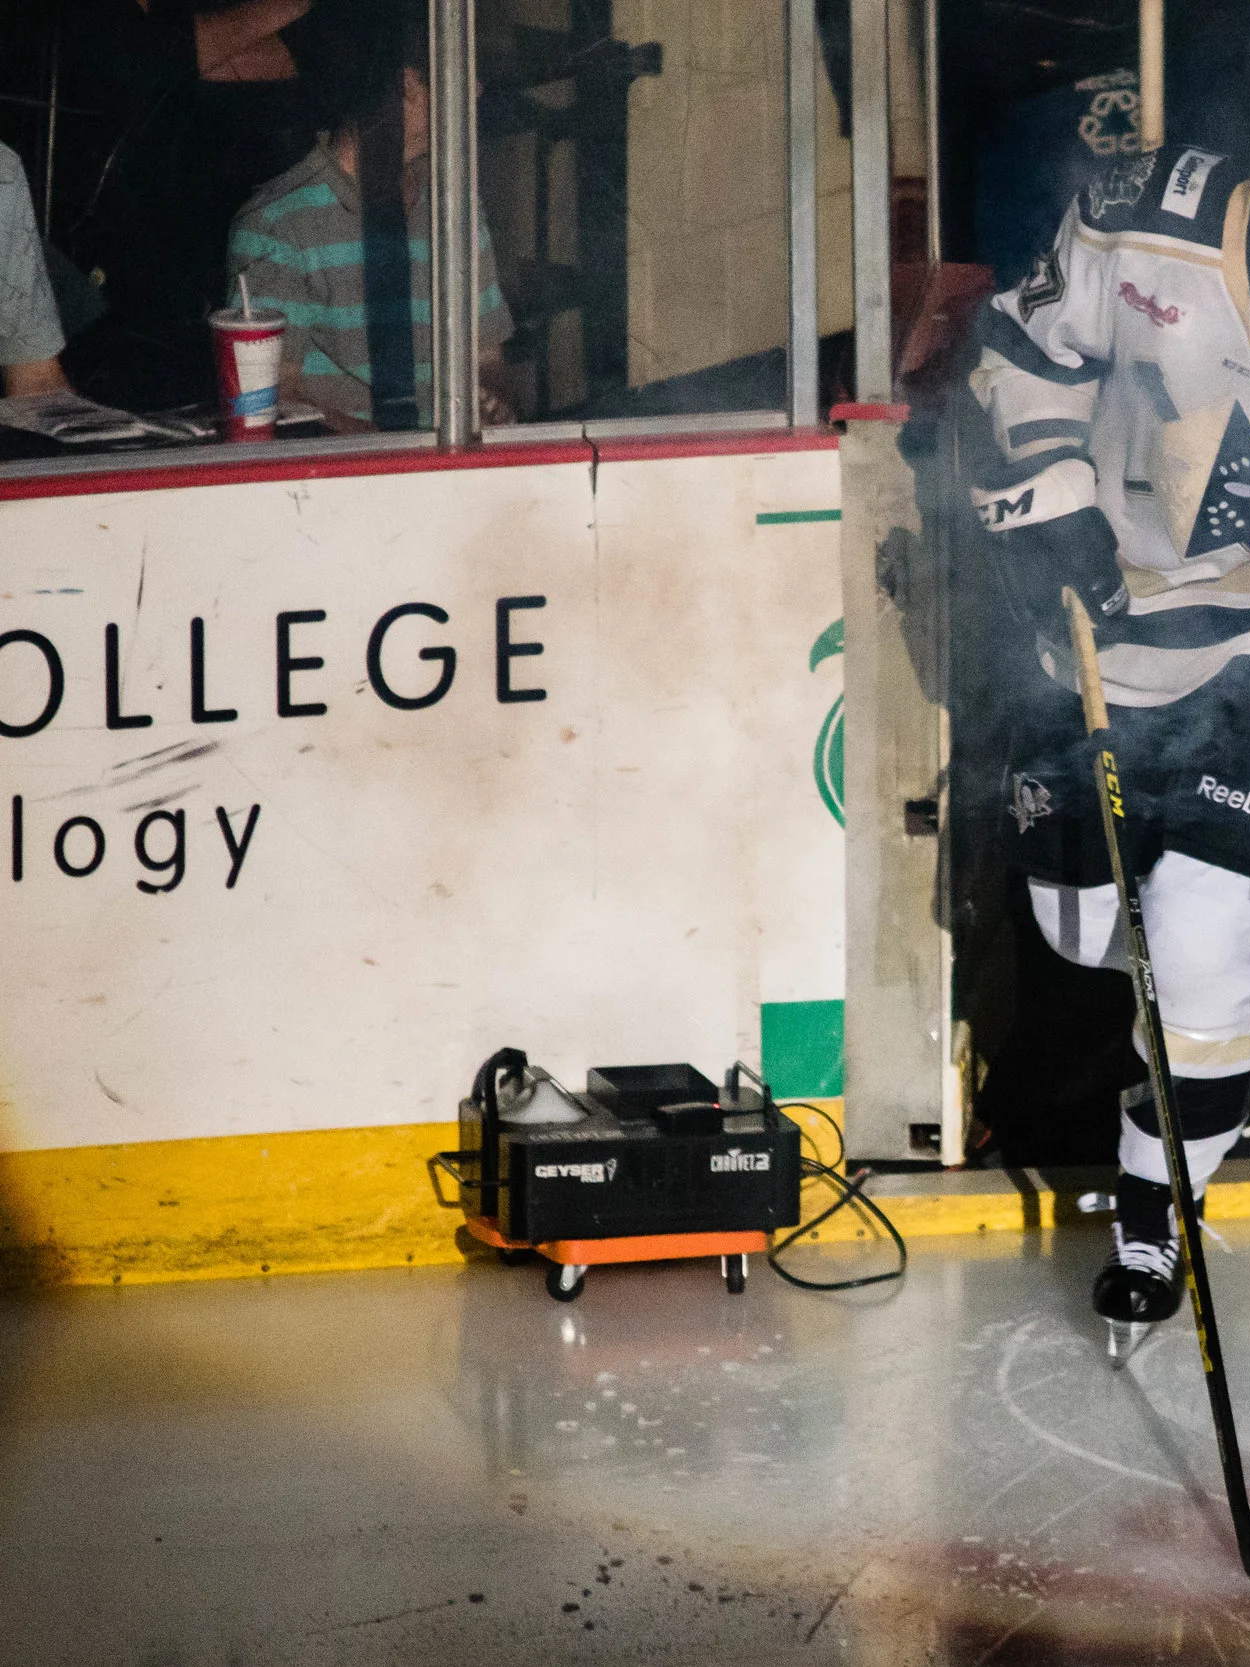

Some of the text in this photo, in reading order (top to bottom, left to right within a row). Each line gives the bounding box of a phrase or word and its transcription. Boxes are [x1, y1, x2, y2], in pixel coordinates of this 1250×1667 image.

[0, 595, 547, 738] OLLEGE
[1102, 751, 1125, 817] CCM
[11, 794, 261, 894] logy
